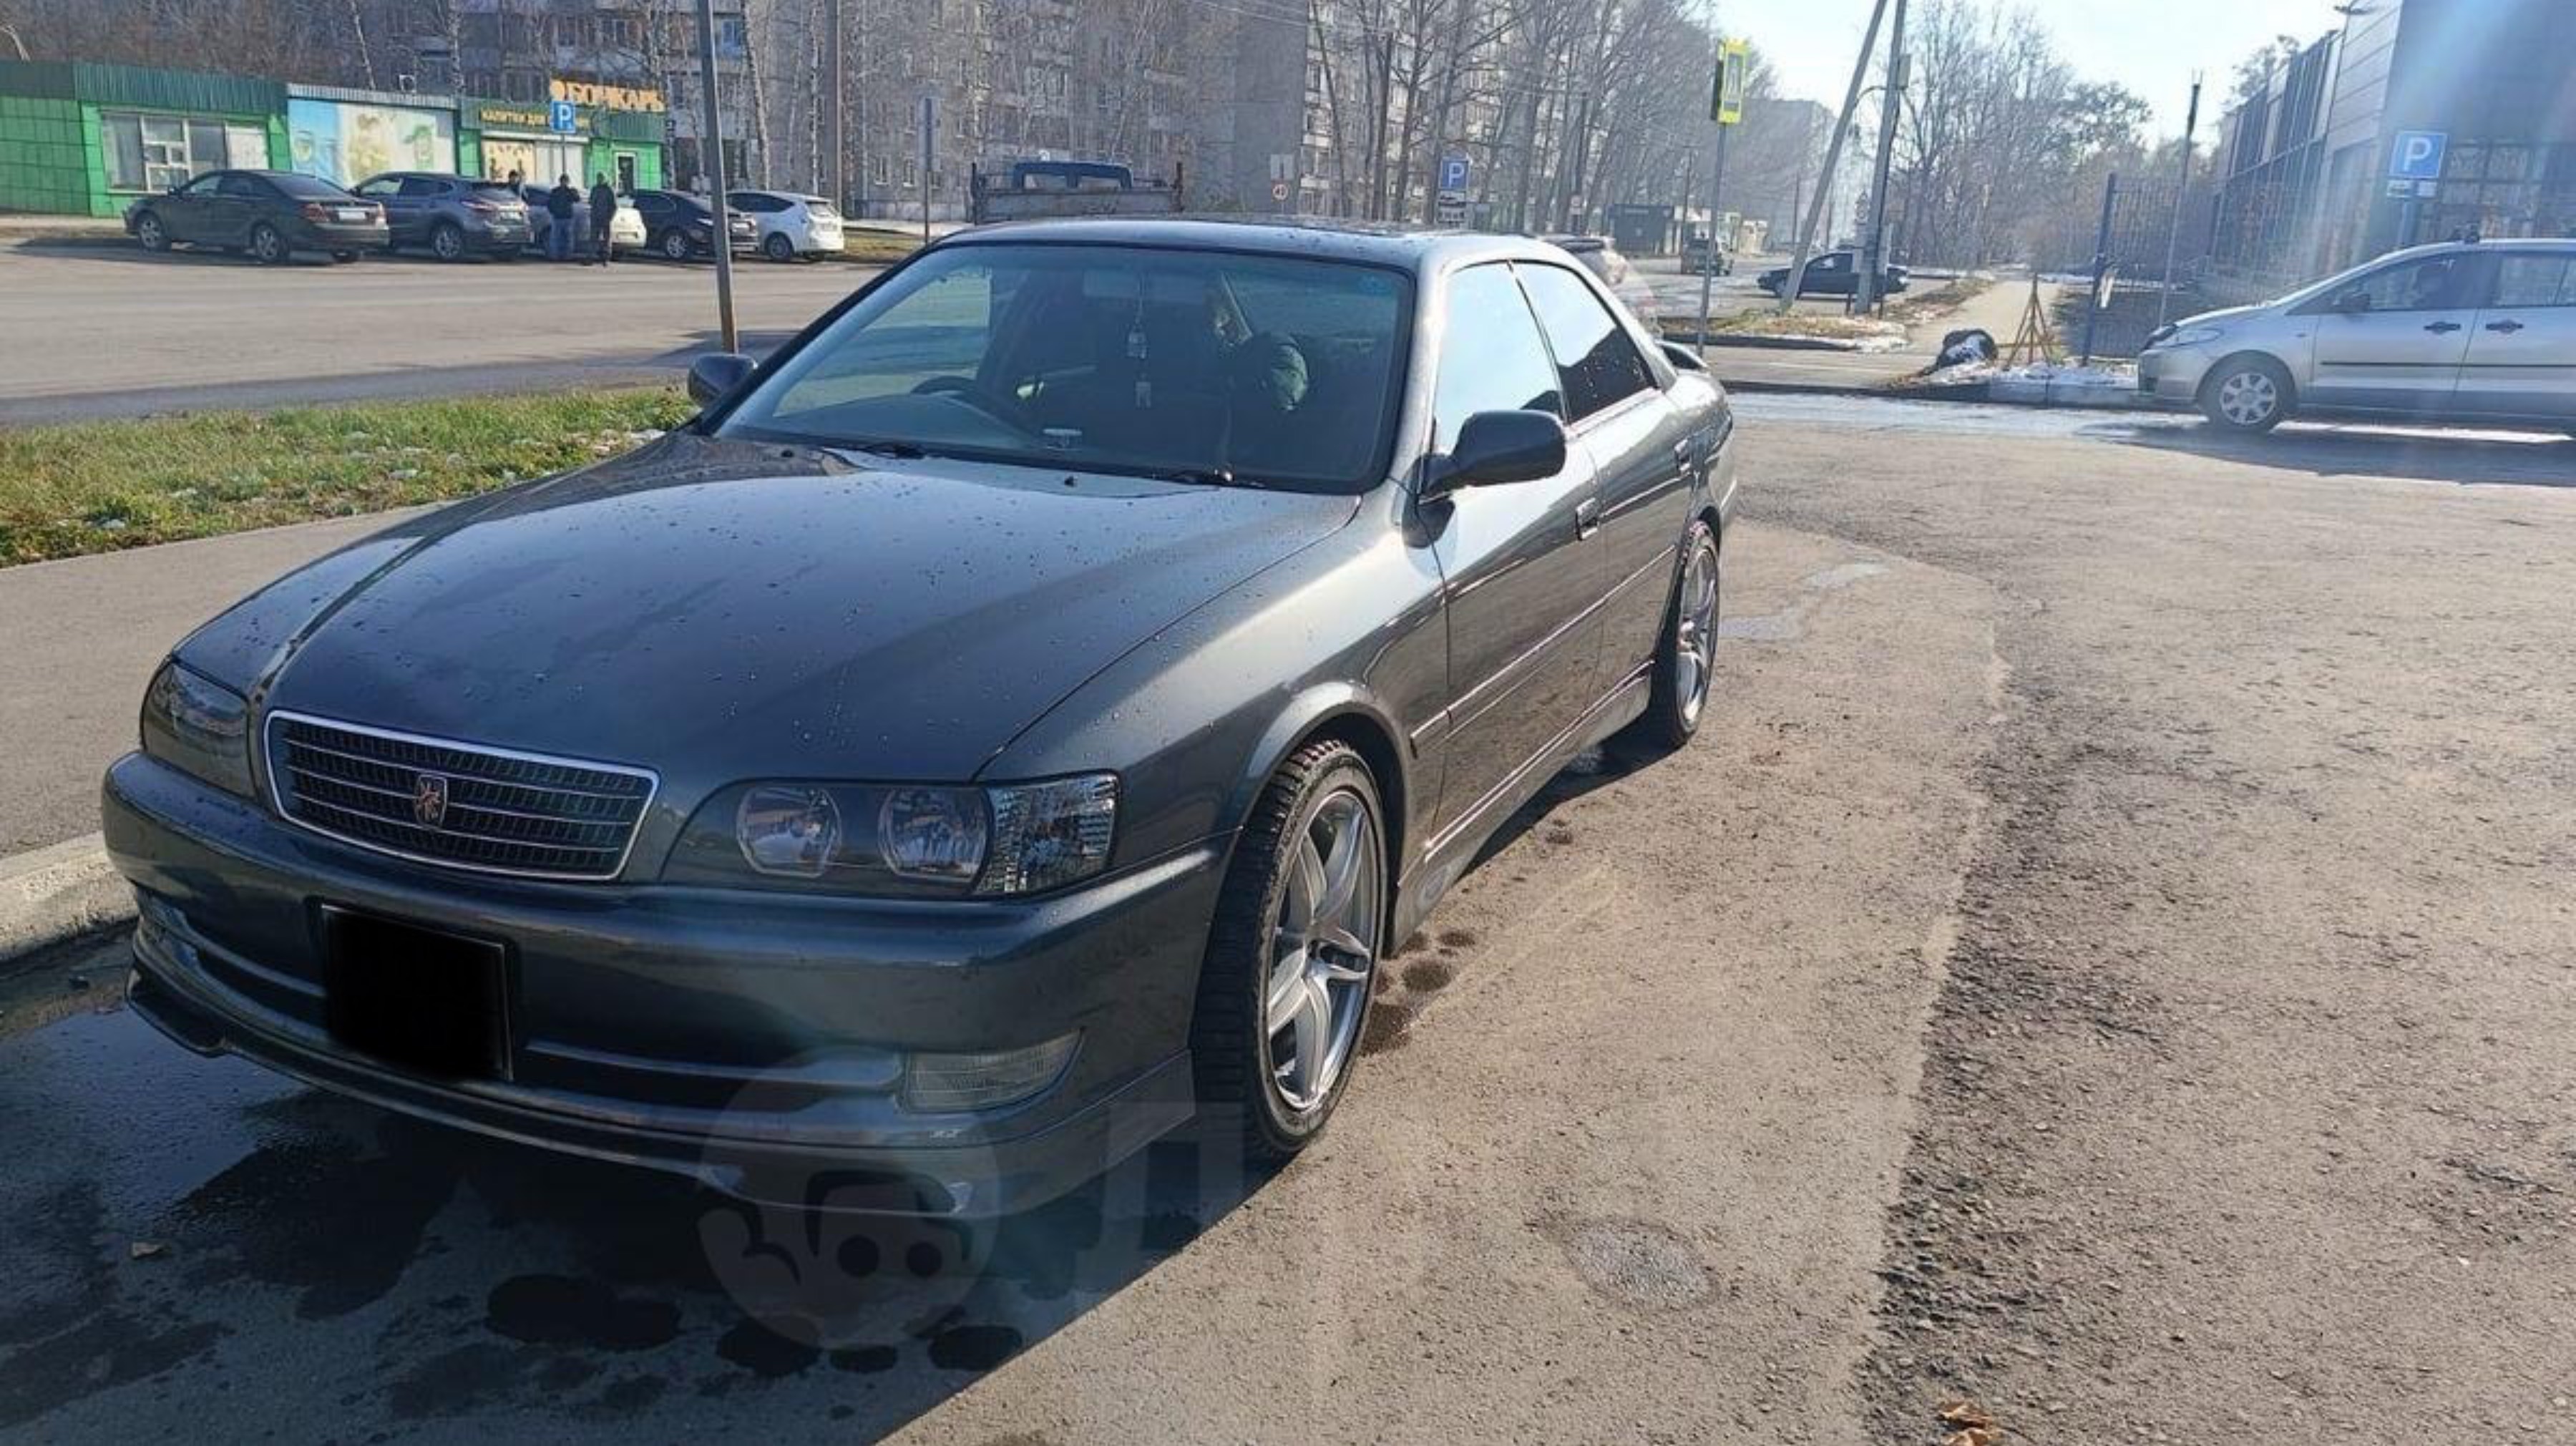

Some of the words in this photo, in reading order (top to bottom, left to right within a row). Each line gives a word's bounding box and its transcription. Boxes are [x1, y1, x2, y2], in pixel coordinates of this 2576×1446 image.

[558, 104, 572, 128] P
[2404, 137, 2431, 172] P
[1448, 162, 1464, 187] P
